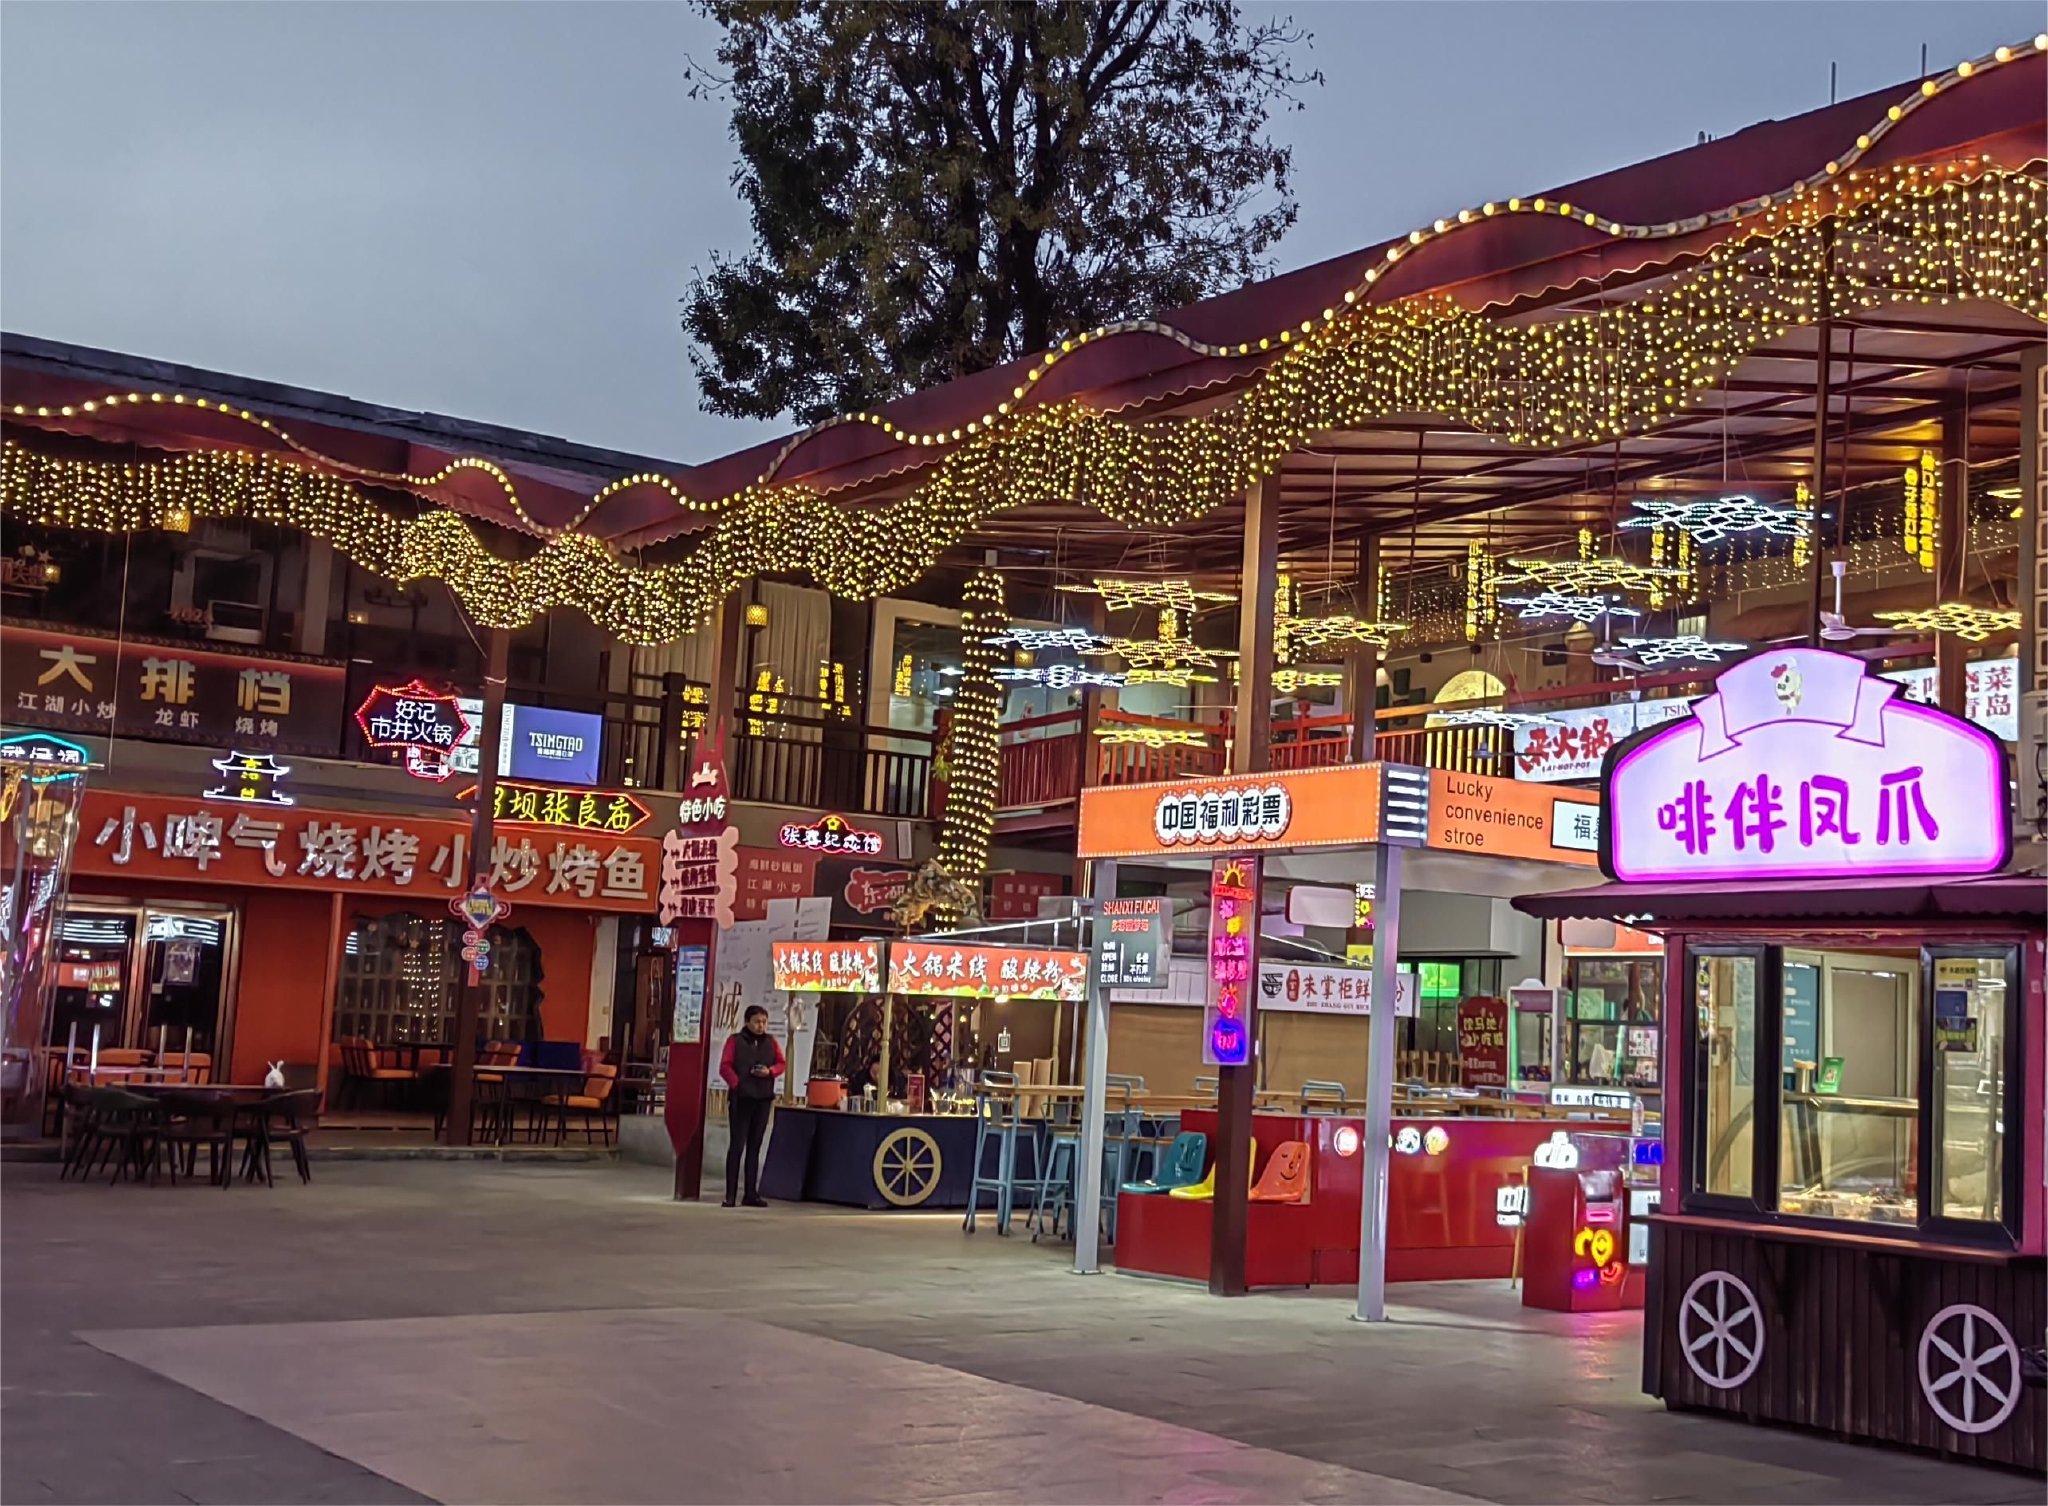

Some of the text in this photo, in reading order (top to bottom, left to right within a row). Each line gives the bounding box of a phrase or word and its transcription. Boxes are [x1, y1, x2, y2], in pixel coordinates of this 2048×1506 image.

[37, 645, 291, 715] 大排档
[18, 690, 279, 738] 江湖小炒 龙虾 烧烤
[394, 698, 437, 723] 好记
[370, 714, 453, 745] 市井火锅
[528, 731, 583, 752] TSINGTAO
[1446, 776, 1494, 803] Lucky
[680, 795, 727, 824] 特色小吃
[1162, 795, 1283, 831] 中国福利彩票
[1445, 803, 1544, 830] convenience
[1657, 766, 1940, 855] 啡伴凤爪
[1443, 828, 1485, 847] stroe
[1103, 902, 1133, 916] SHANXI
[899, 949, 1064, 984] 火锅米线 酸辣粉
